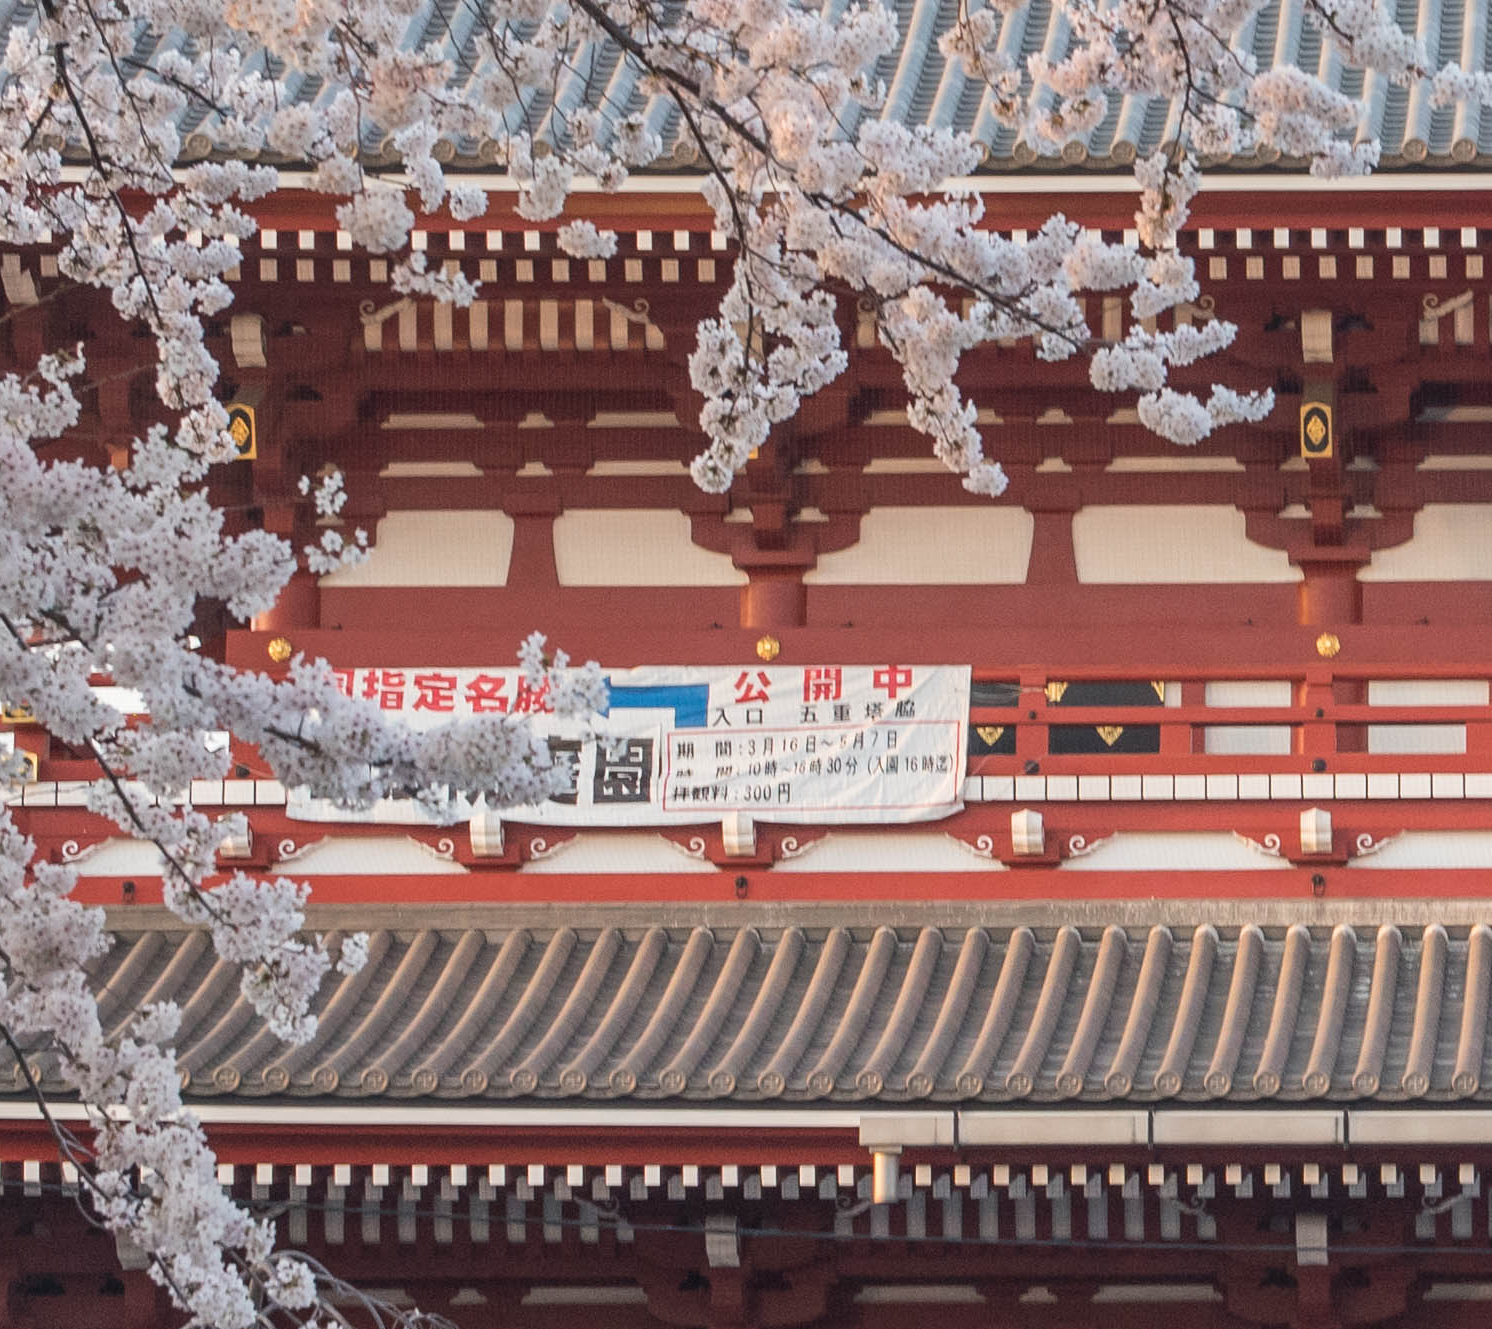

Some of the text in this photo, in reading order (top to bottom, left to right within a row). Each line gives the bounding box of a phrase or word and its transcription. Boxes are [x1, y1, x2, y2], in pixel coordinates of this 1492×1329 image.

[734, 664, 913, 705] 公開中
[712, 707, 765, 727] 入口
